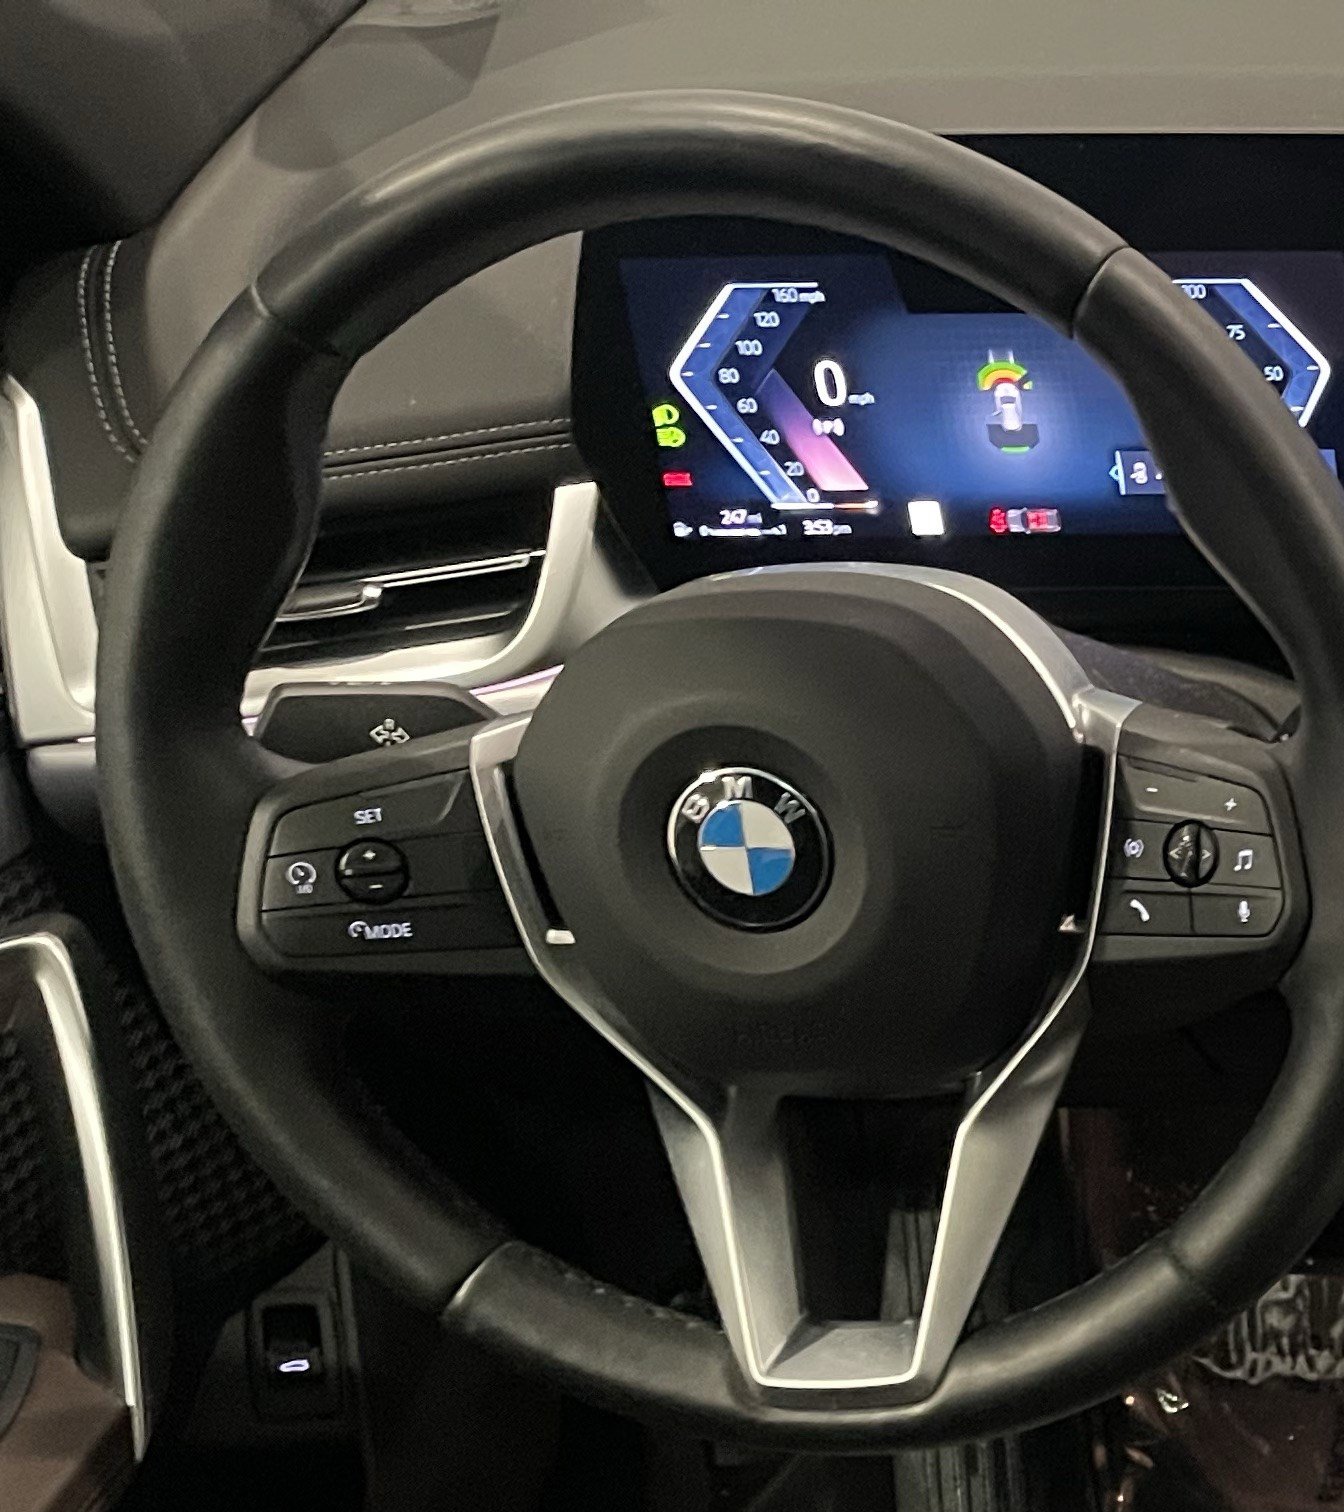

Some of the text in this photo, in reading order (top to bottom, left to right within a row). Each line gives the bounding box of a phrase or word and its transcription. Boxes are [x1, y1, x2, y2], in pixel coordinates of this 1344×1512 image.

[771, 287, 799, 303] 160
[753, 311, 781, 328] 120
[1226, 324, 1246, 340] 75
[735, 339, 764, 356] 100
[717, 367, 740, 384] 80
[1263, 365, 1285, 381] 50
[814, 359, 848, 407] 0
[736, 397, 758, 414] 60
[784, 461, 805, 477] 20
[681, 775, 806, 824] BMW
[353, 807, 382, 825] SET
[364, 922, 413, 939] MODE
